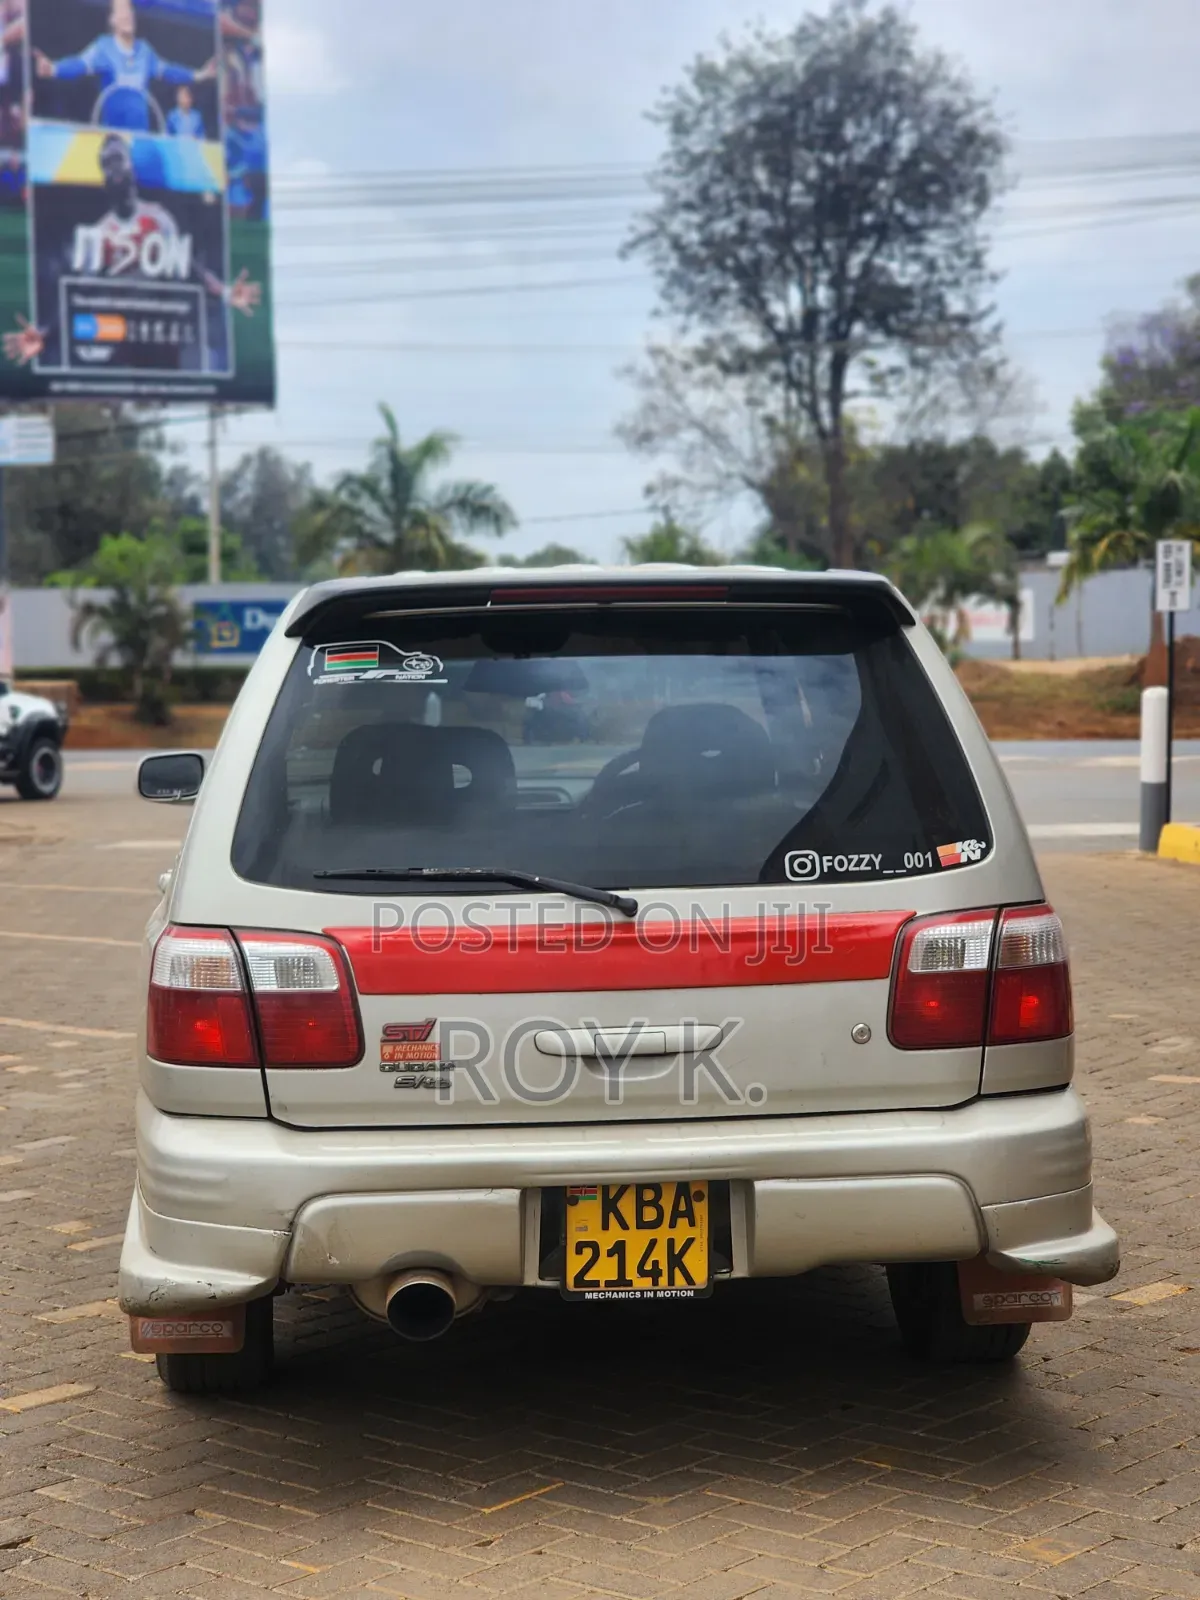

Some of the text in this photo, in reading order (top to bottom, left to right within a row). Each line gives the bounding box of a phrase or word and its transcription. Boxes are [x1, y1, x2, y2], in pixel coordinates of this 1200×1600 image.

[394, 1044, 439, 1052] MECHANICS
[394, 1052, 438, 1060] IN MOTION
[601, 1182, 696, 1231] KBA
[573, 1237, 697, 1288] 214K
[585, 1291, 641, 1300] MECHANICS
[657, 1290, 694, 1298] MOTION
[151, 1322, 224, 1336] sparco
